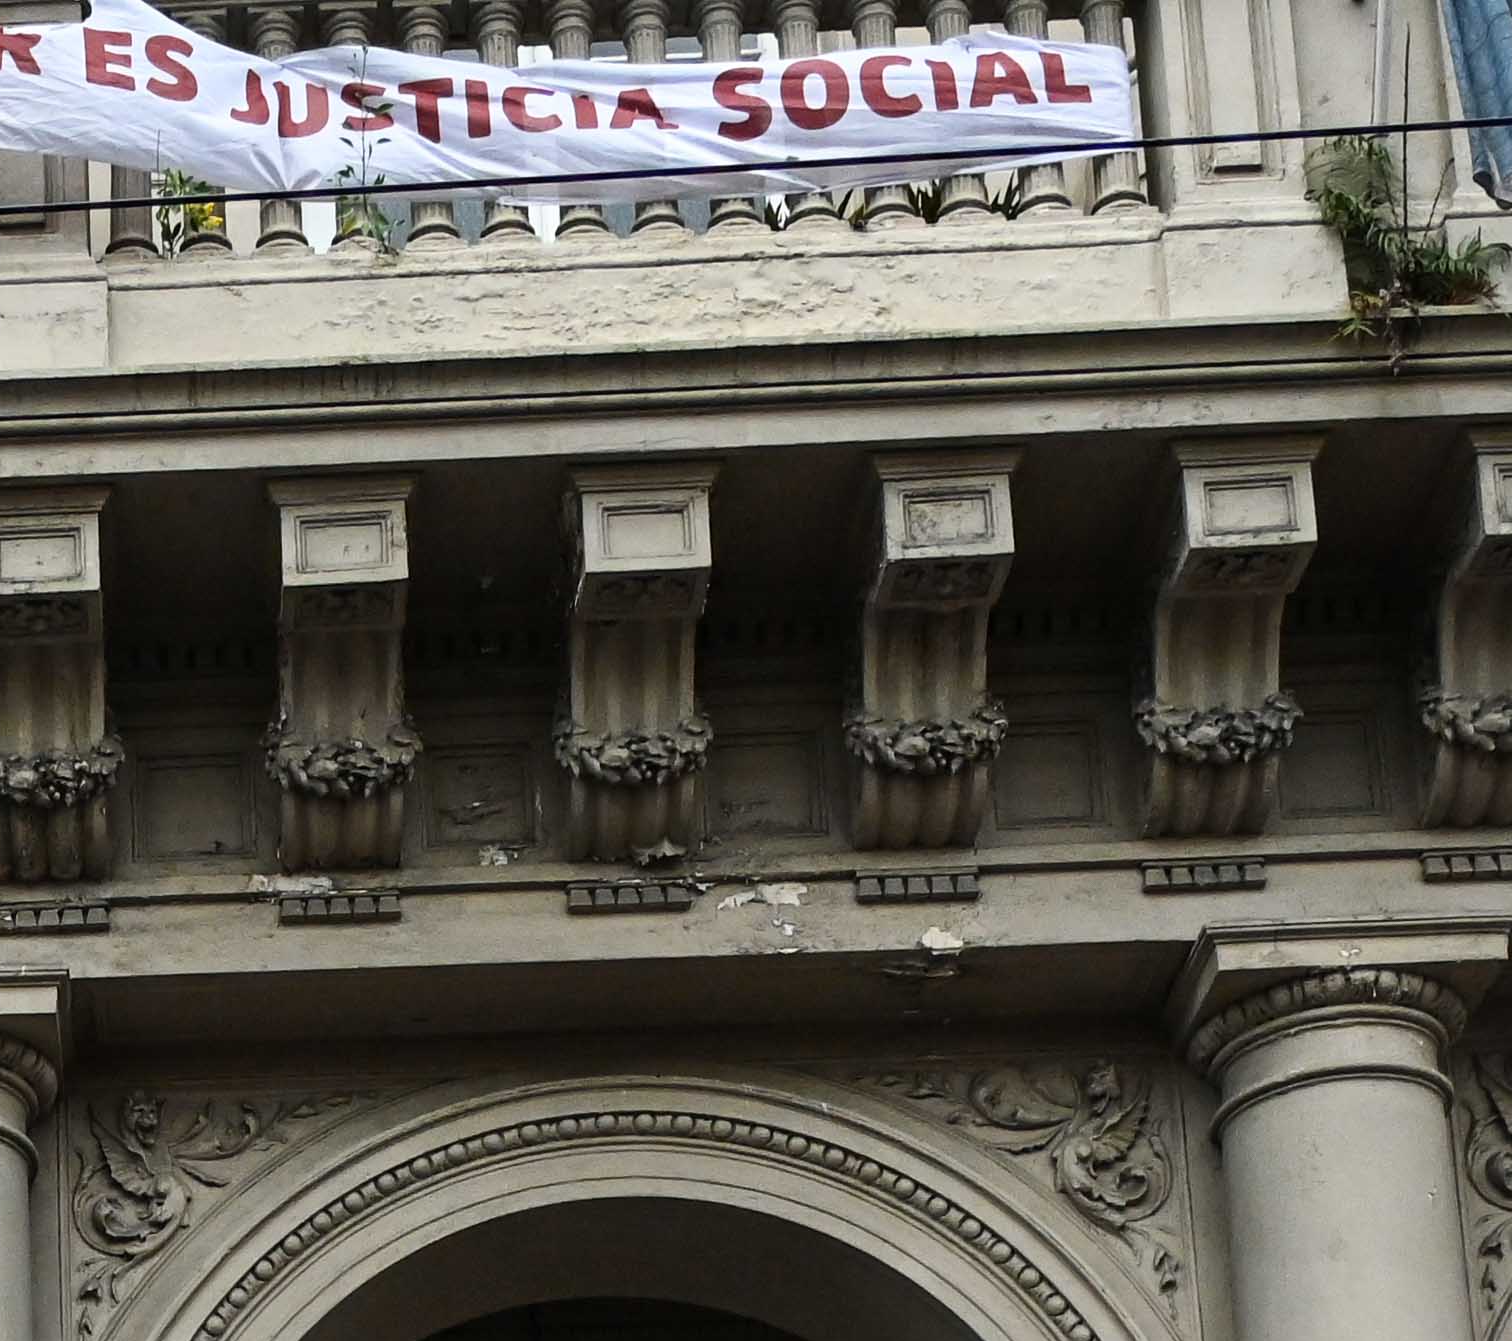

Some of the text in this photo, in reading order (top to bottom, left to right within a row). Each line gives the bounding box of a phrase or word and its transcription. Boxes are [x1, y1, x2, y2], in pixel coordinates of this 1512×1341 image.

[83, 28, 200, 102] ES
[231, 64, 679, 139] JUSTICIA
[712, 47, 1094, 141] SOCIAL
